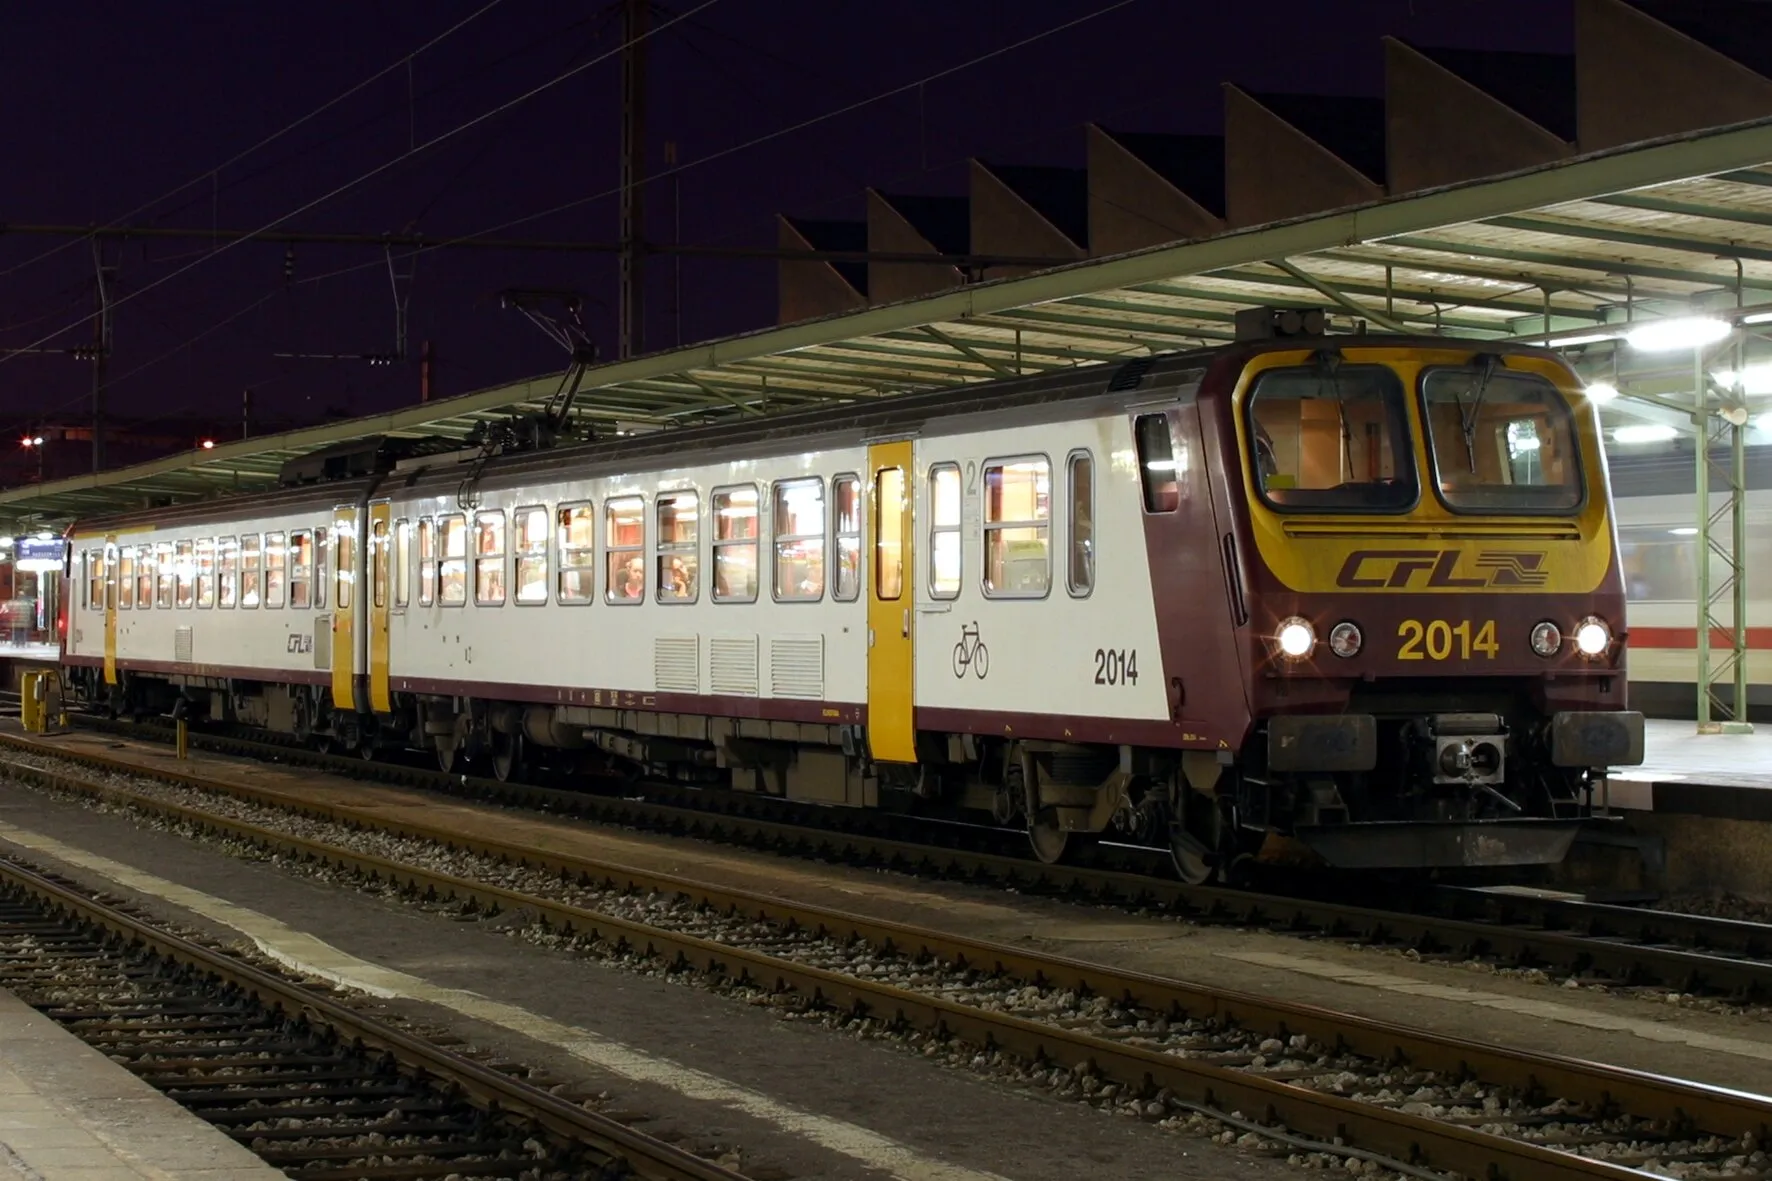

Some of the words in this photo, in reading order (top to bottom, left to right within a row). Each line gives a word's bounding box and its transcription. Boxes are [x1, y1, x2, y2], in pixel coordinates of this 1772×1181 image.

[1336, 550, 1487, 588] CFL
[1397, 619, 1499, 660] 2014
[1094, 648, 1138, 686] 2014
